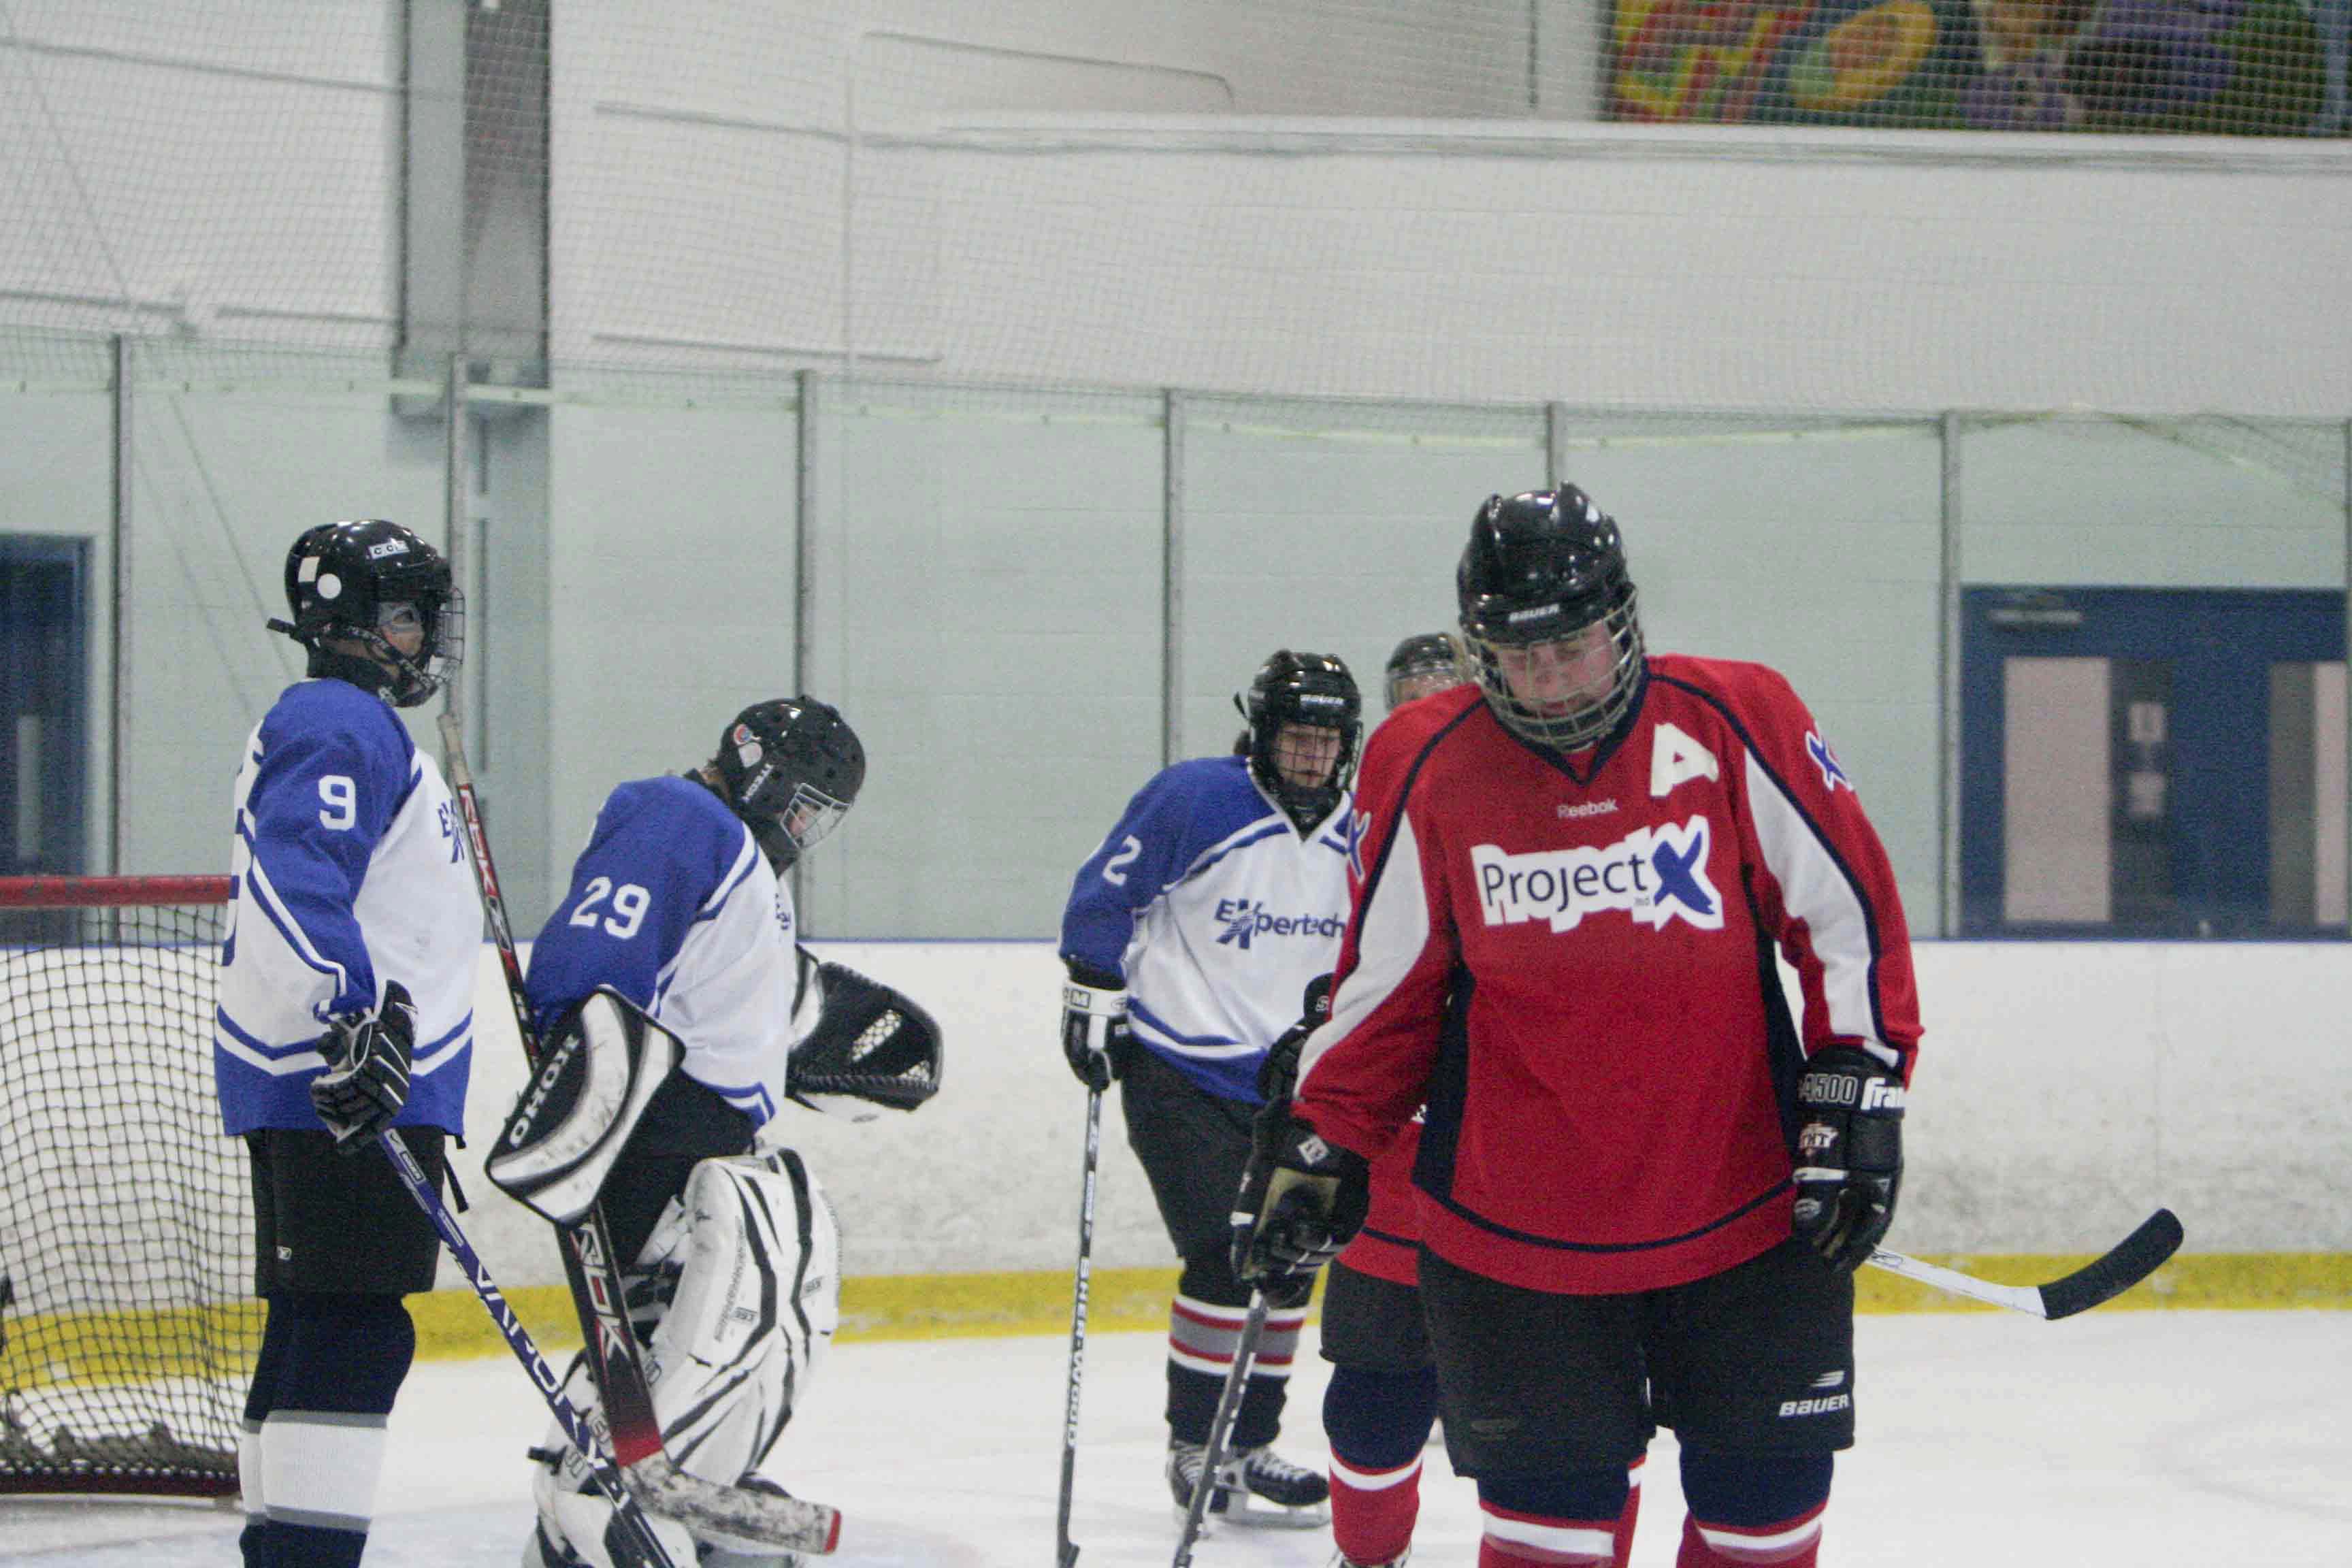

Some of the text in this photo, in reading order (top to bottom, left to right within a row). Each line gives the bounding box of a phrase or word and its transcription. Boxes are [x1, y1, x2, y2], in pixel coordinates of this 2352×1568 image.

[1650, 723, 1720, 798] A
[318, 774, 357, 831] 9
[1557, 798, 1618, 819] Reebok
[1102, 834, 1142, 886] 2
[569, 876, 651, 939] 29
[509, 1032, 580, 1148] KOHO
[1778, 1393, 1850, 1417] BAUER
